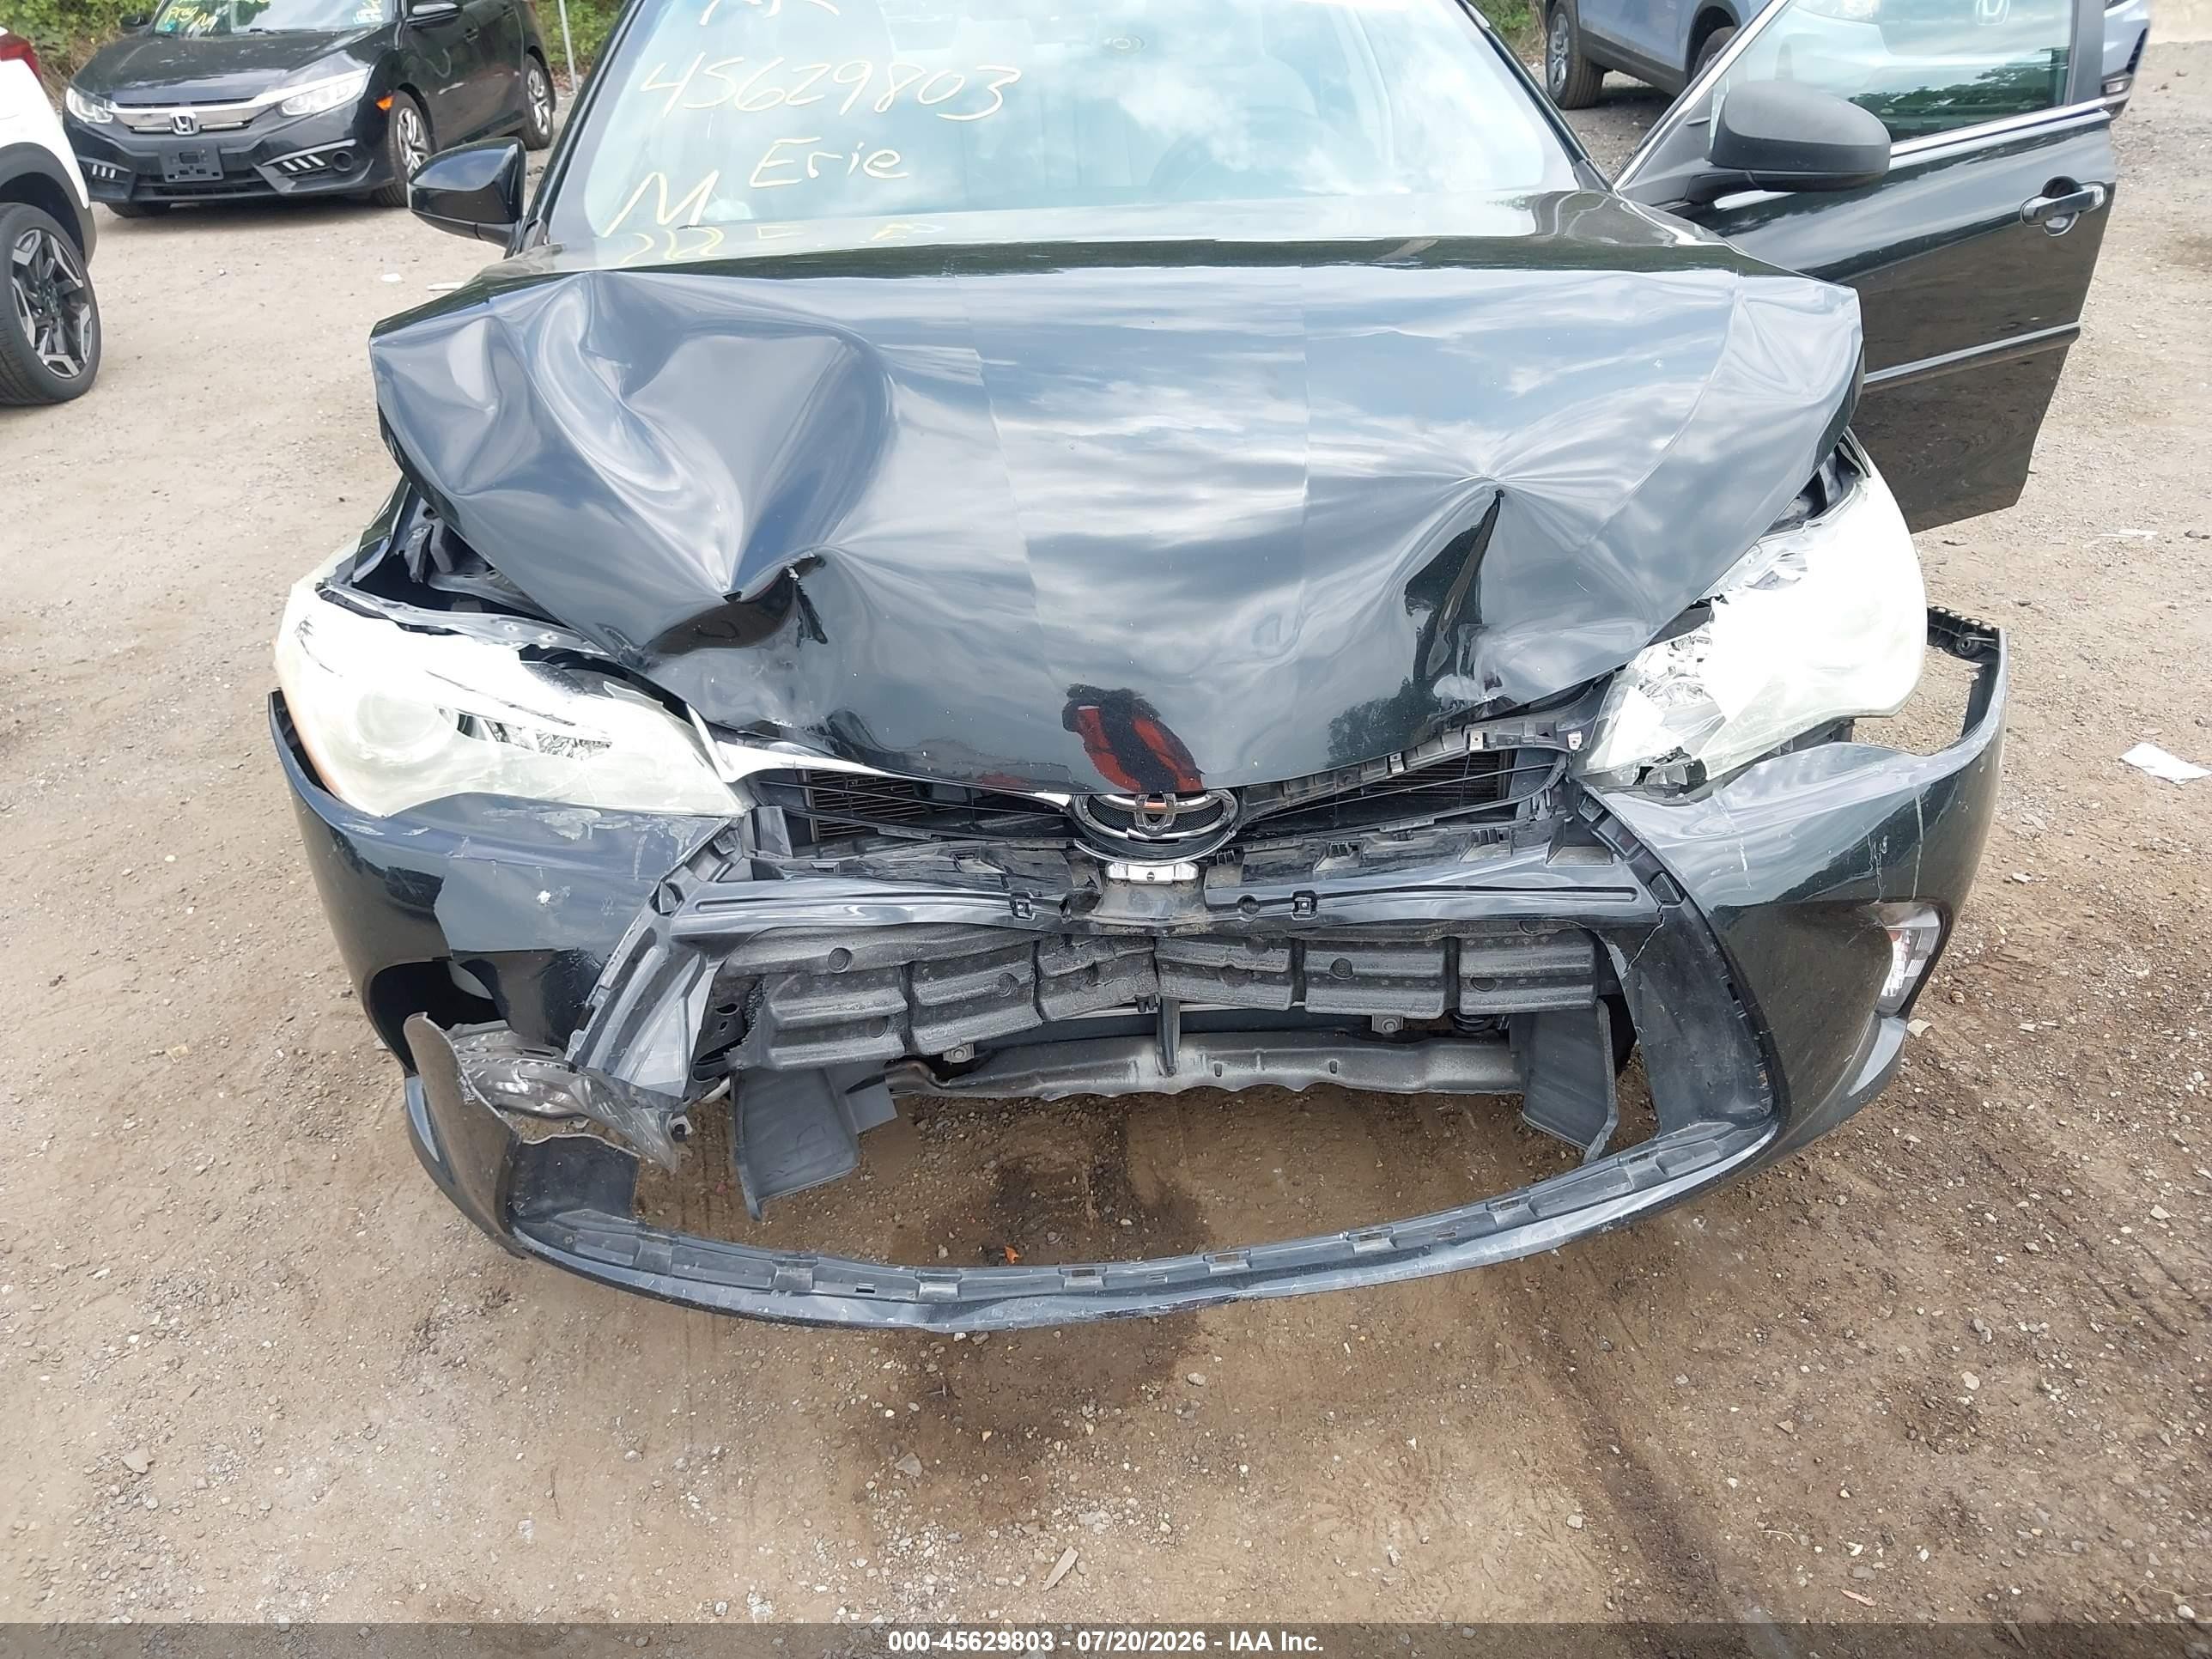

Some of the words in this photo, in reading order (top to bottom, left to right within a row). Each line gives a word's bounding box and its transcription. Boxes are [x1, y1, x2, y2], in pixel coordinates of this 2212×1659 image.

[641, 52, 1021, 121] 45629803
[748, 137, 909, 188] Erie
[601, 170, 720, 238] M
